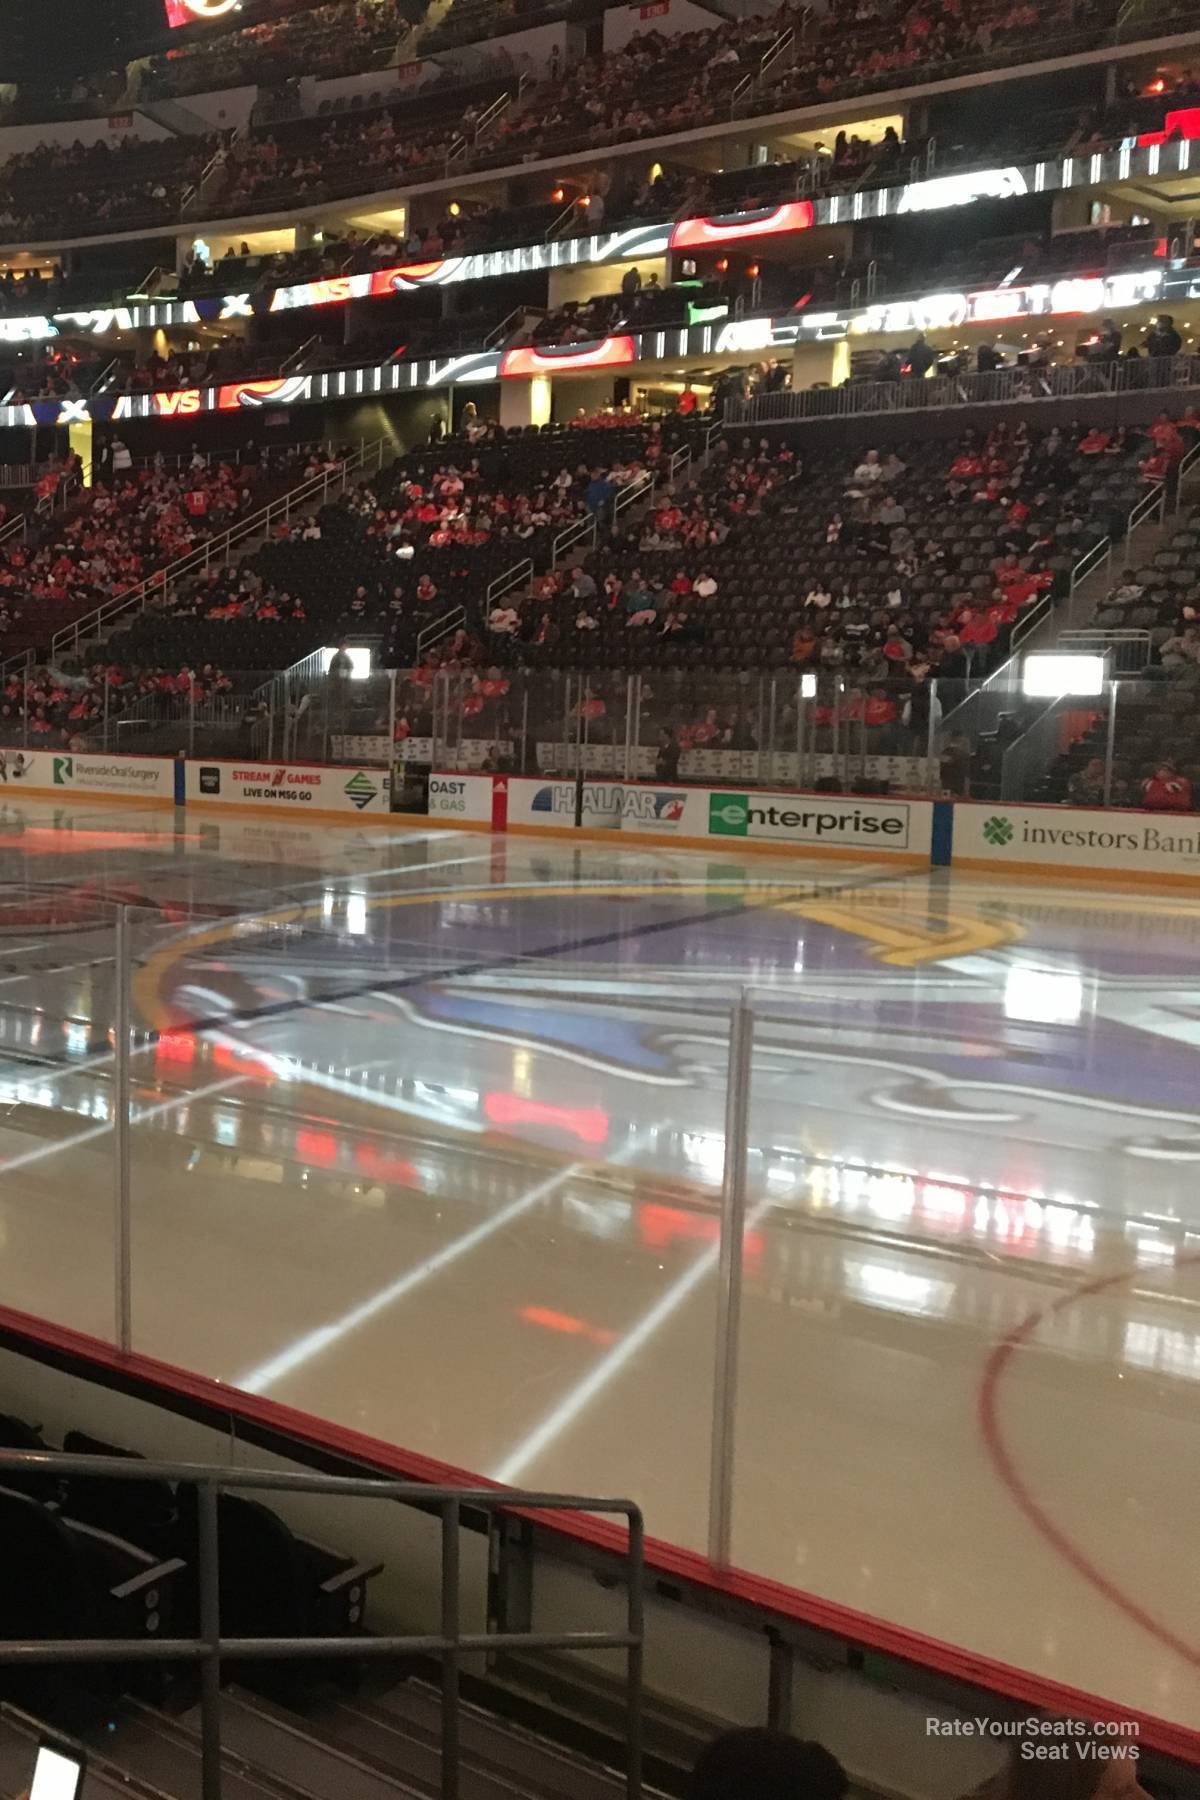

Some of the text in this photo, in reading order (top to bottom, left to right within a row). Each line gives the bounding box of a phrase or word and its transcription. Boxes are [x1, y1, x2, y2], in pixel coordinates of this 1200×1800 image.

[155, 390, 200, 415] VS
[232, 771, 321, 786] STREAM GAMES
[243, 788, 312, 801] LIVE ON MSG GO
[439, 800, 466, 812] GAS
[711, 804, 904, 835] enterprise
